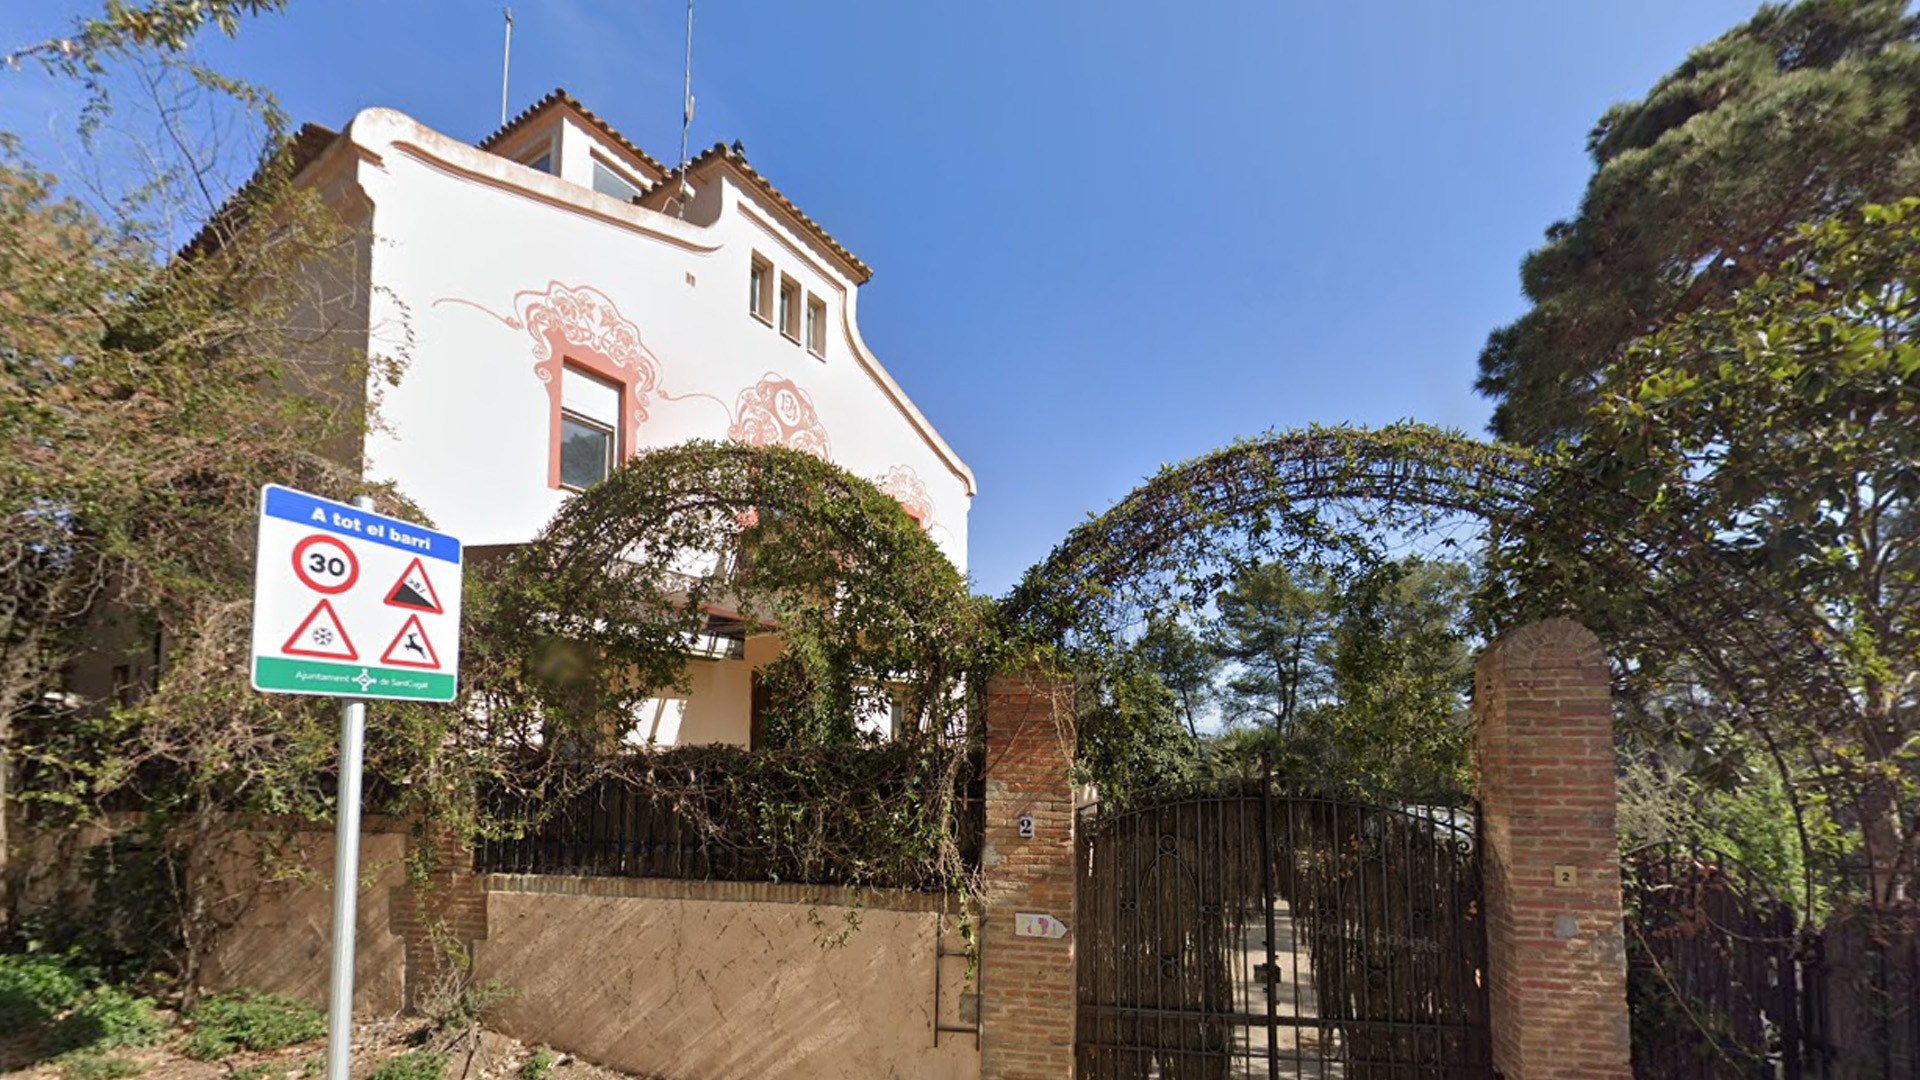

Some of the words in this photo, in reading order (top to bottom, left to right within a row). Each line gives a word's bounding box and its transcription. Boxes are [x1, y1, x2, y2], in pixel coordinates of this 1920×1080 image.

[311, 507, 327, 523] A
[332, 512, 362, 532] tot
[366, 524, 385, 537] el
[389, 528, 431, 550] barri
[309, 553, 345, 576] 30
[295, 670, 350, 682] Ajuntament
[1020, 819, 1031, 834] 2
[1561, 871, 1571, 882] 2
